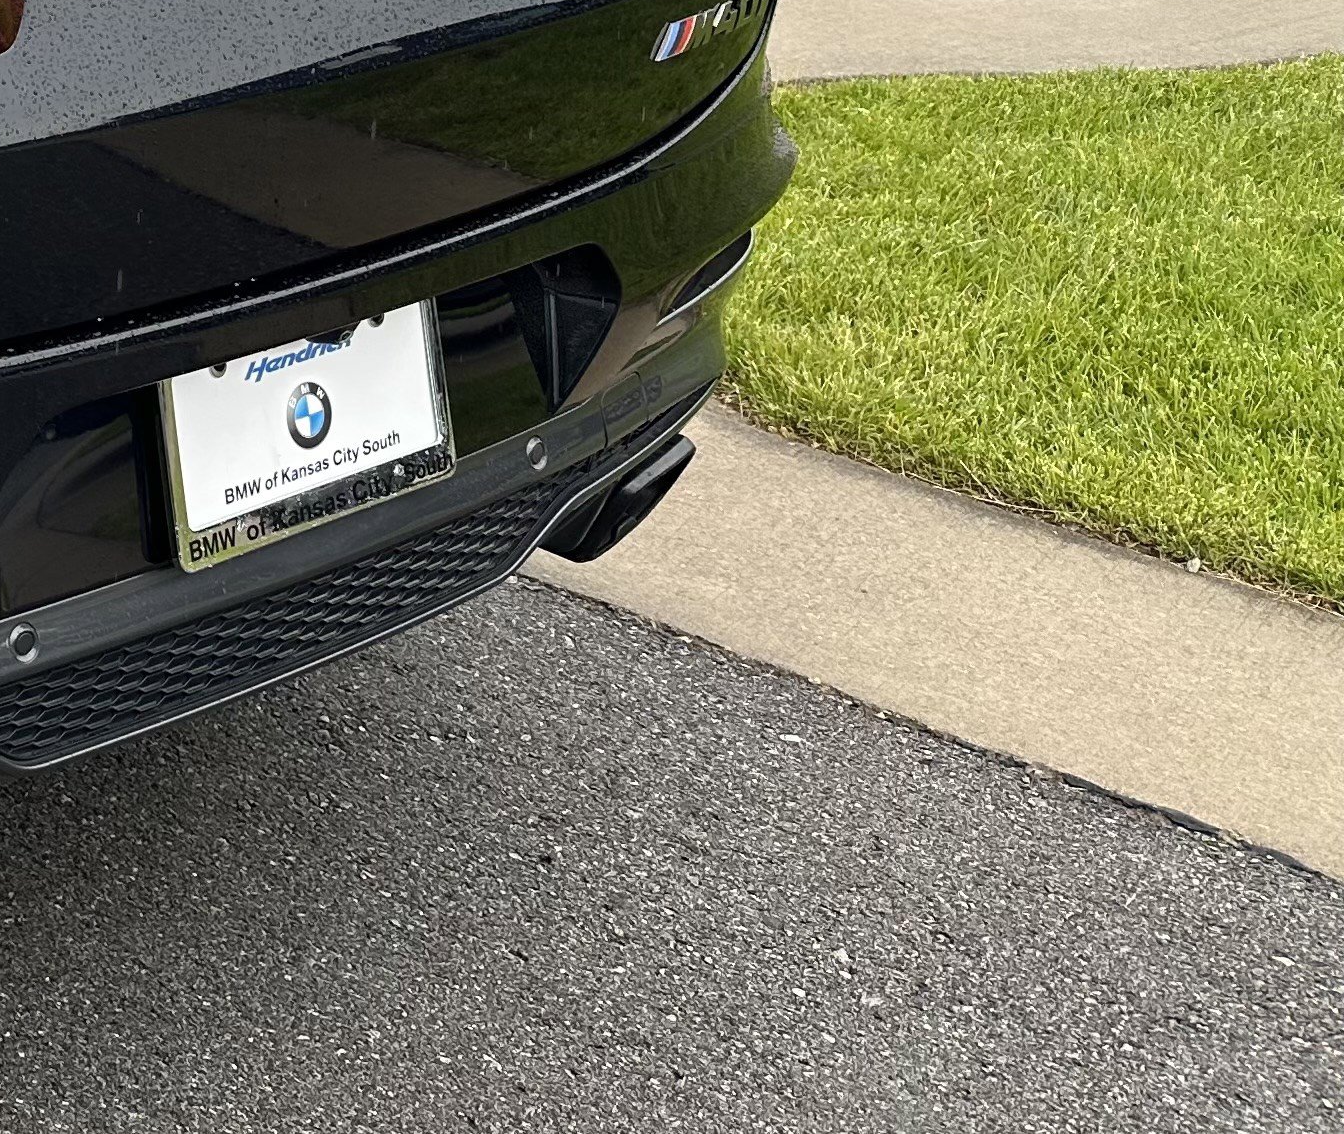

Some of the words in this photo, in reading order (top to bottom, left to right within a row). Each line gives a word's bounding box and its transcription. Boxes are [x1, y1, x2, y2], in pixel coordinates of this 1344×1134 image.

[189, 525, 236, 563] BMW
[246, 520, 266, 541] of
[272, 491, 347, 532] Kansas
[352, 473, 393, 503] City
[404, 450, 455, 483] South
[224, 477, 261, 505] BMW
[265, 471, 278, 491] of
[282, 458, 329, 482] Kansas
[333, 446, 359, 468] City
[362, 430, 401, 456] South
